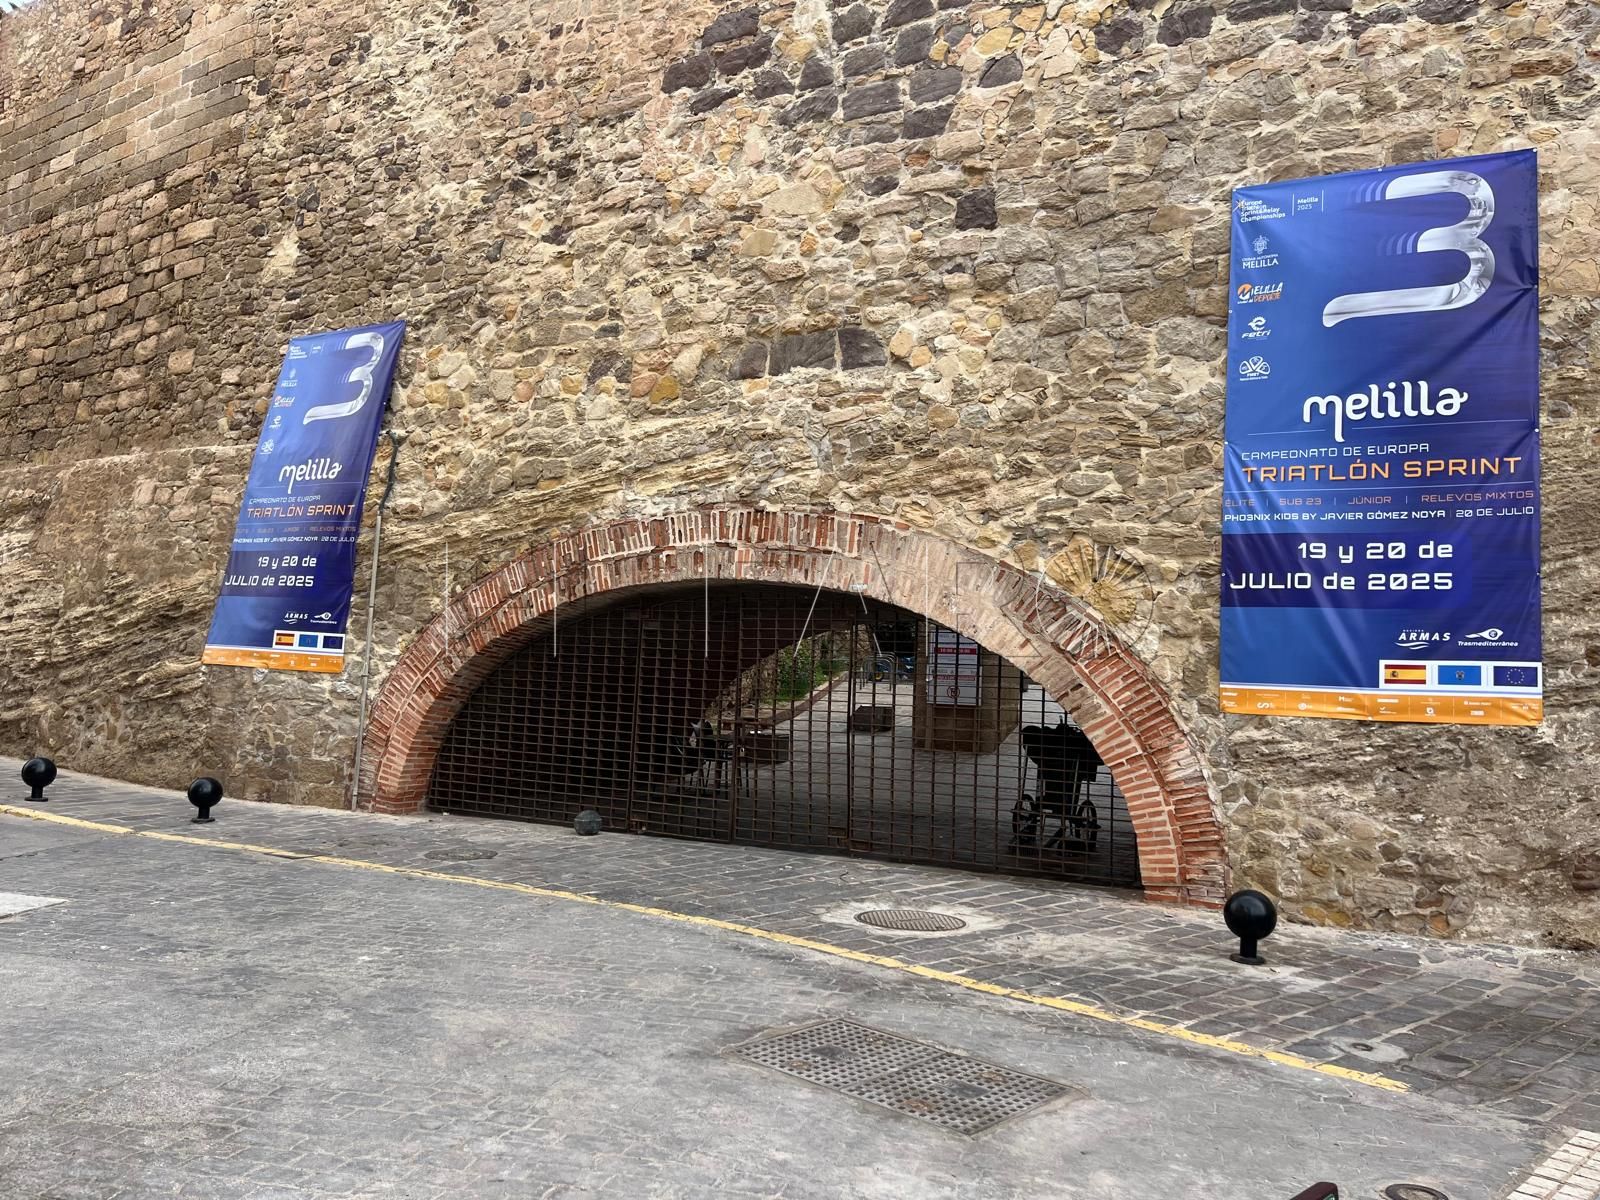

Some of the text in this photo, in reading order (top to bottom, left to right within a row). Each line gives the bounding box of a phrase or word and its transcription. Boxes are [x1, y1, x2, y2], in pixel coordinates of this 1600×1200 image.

[1240, 212, 1286, 223] Championships
[1242, 258, 1279, 269] MELILLA
[1303, 381, 1468, 442] melilla
[1242, 443, 1430, 460] CAMPEONATO DE EUROPA
[279, 458, 342, 493] melilla
[1242, 457, 1522, 482] TRIATLÓN SPRINT
[298, 495, 321, 503] EUROPA
[1306, 497, 1322, 505] 23
[1348, 496, 1392, 505] JÚNIOR
[1421, 492, 1482, 503] RELEVOS
[1485, 490, 1534, 501] MIXTOS
[247, 504, 355, 518] TRIATLÓN SPRINT
[1224, 514, 1271, 522] PHO3NIX
[1302, 512, 1318, 520] BY
[1320, 512, 1364, 520] JAVIER
[1366, 510, 1408, 519] GÓMEZ
[1412, 510, 1446, 519] NOYA
[1456, 509, 1473, 518] 20
[1477, 508, 1493, 516] DE
[1496, 506, 1534, 516] JULIO
[1297, 541, 1453, 563] 19 y 20 de
[258, 556, 317, 569] 19 y 20 de
[225, 575, 314, 587] JULIO de 2025
[1230, 572, 1453, 590] JULIO de 2025
[1398, 632, 1450, 641] ARMAS
